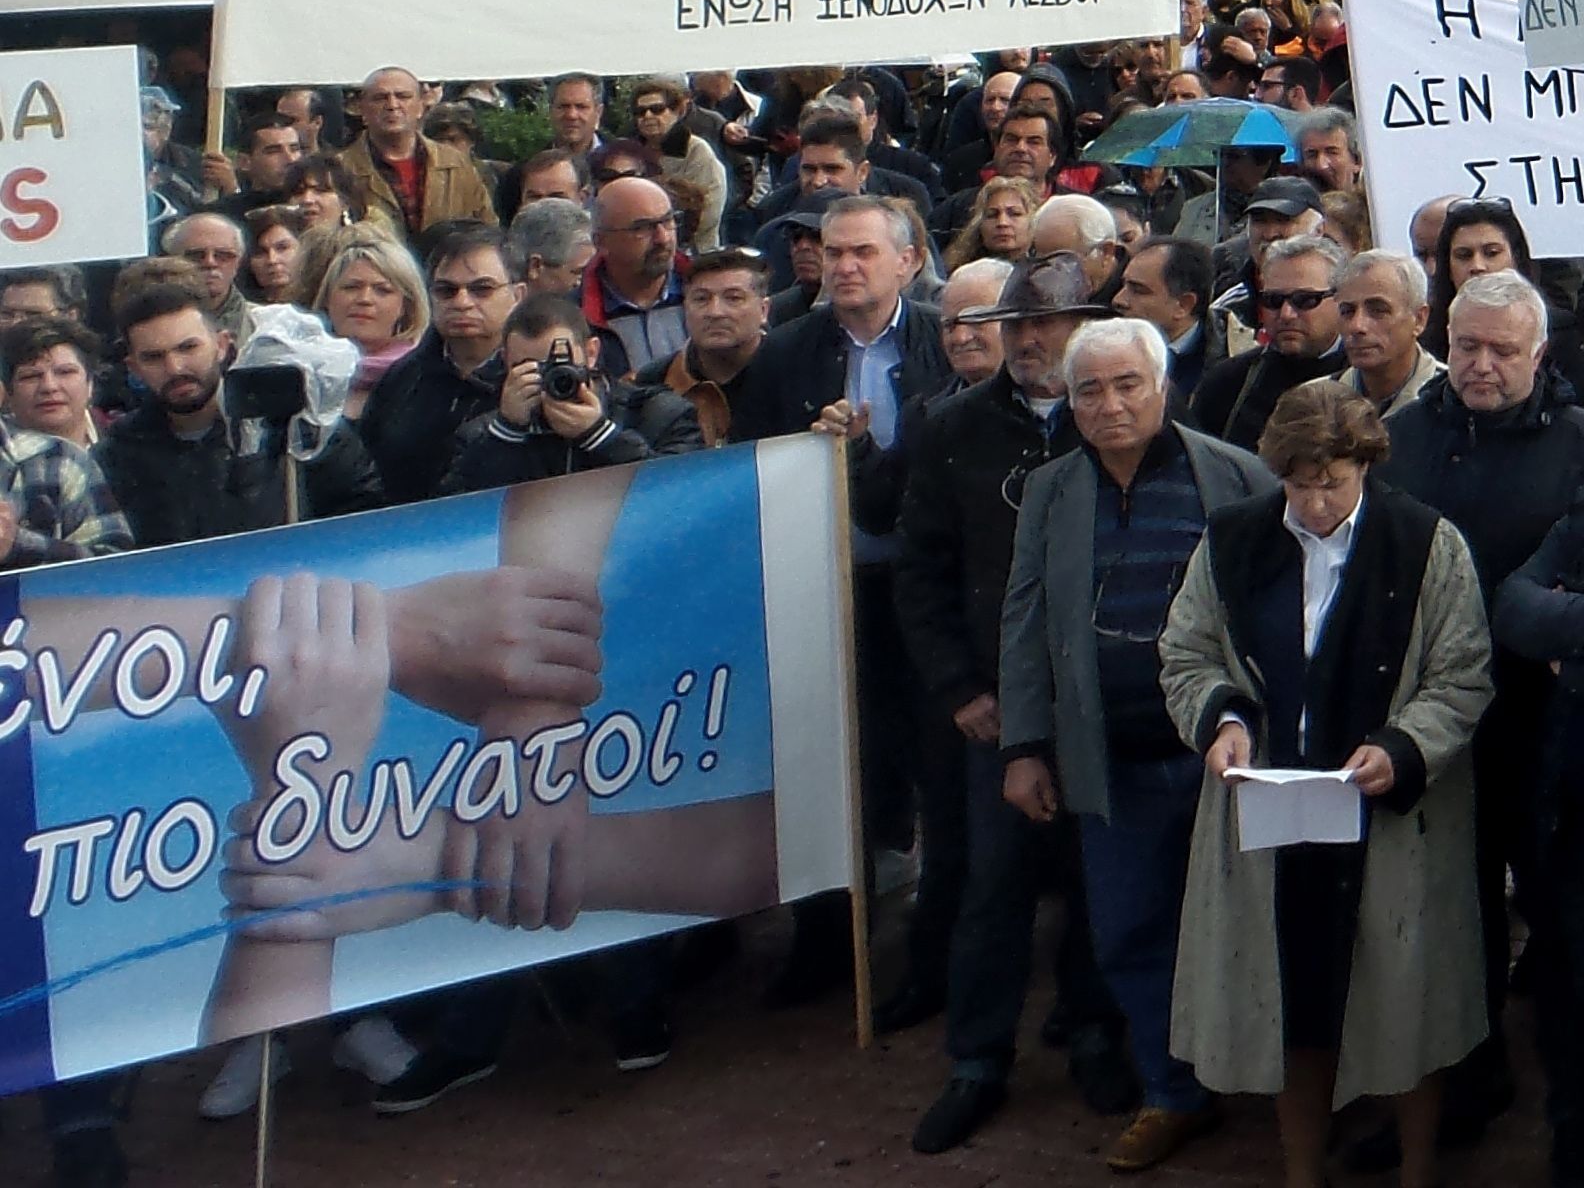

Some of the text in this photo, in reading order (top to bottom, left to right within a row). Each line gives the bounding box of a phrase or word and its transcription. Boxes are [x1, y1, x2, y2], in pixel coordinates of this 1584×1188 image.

[0, 79, 65, 142] Α
[1383, 73, 1494, 129] ΔΕΝ
[23, 664, 731, 920] πιο δυνατοί!
